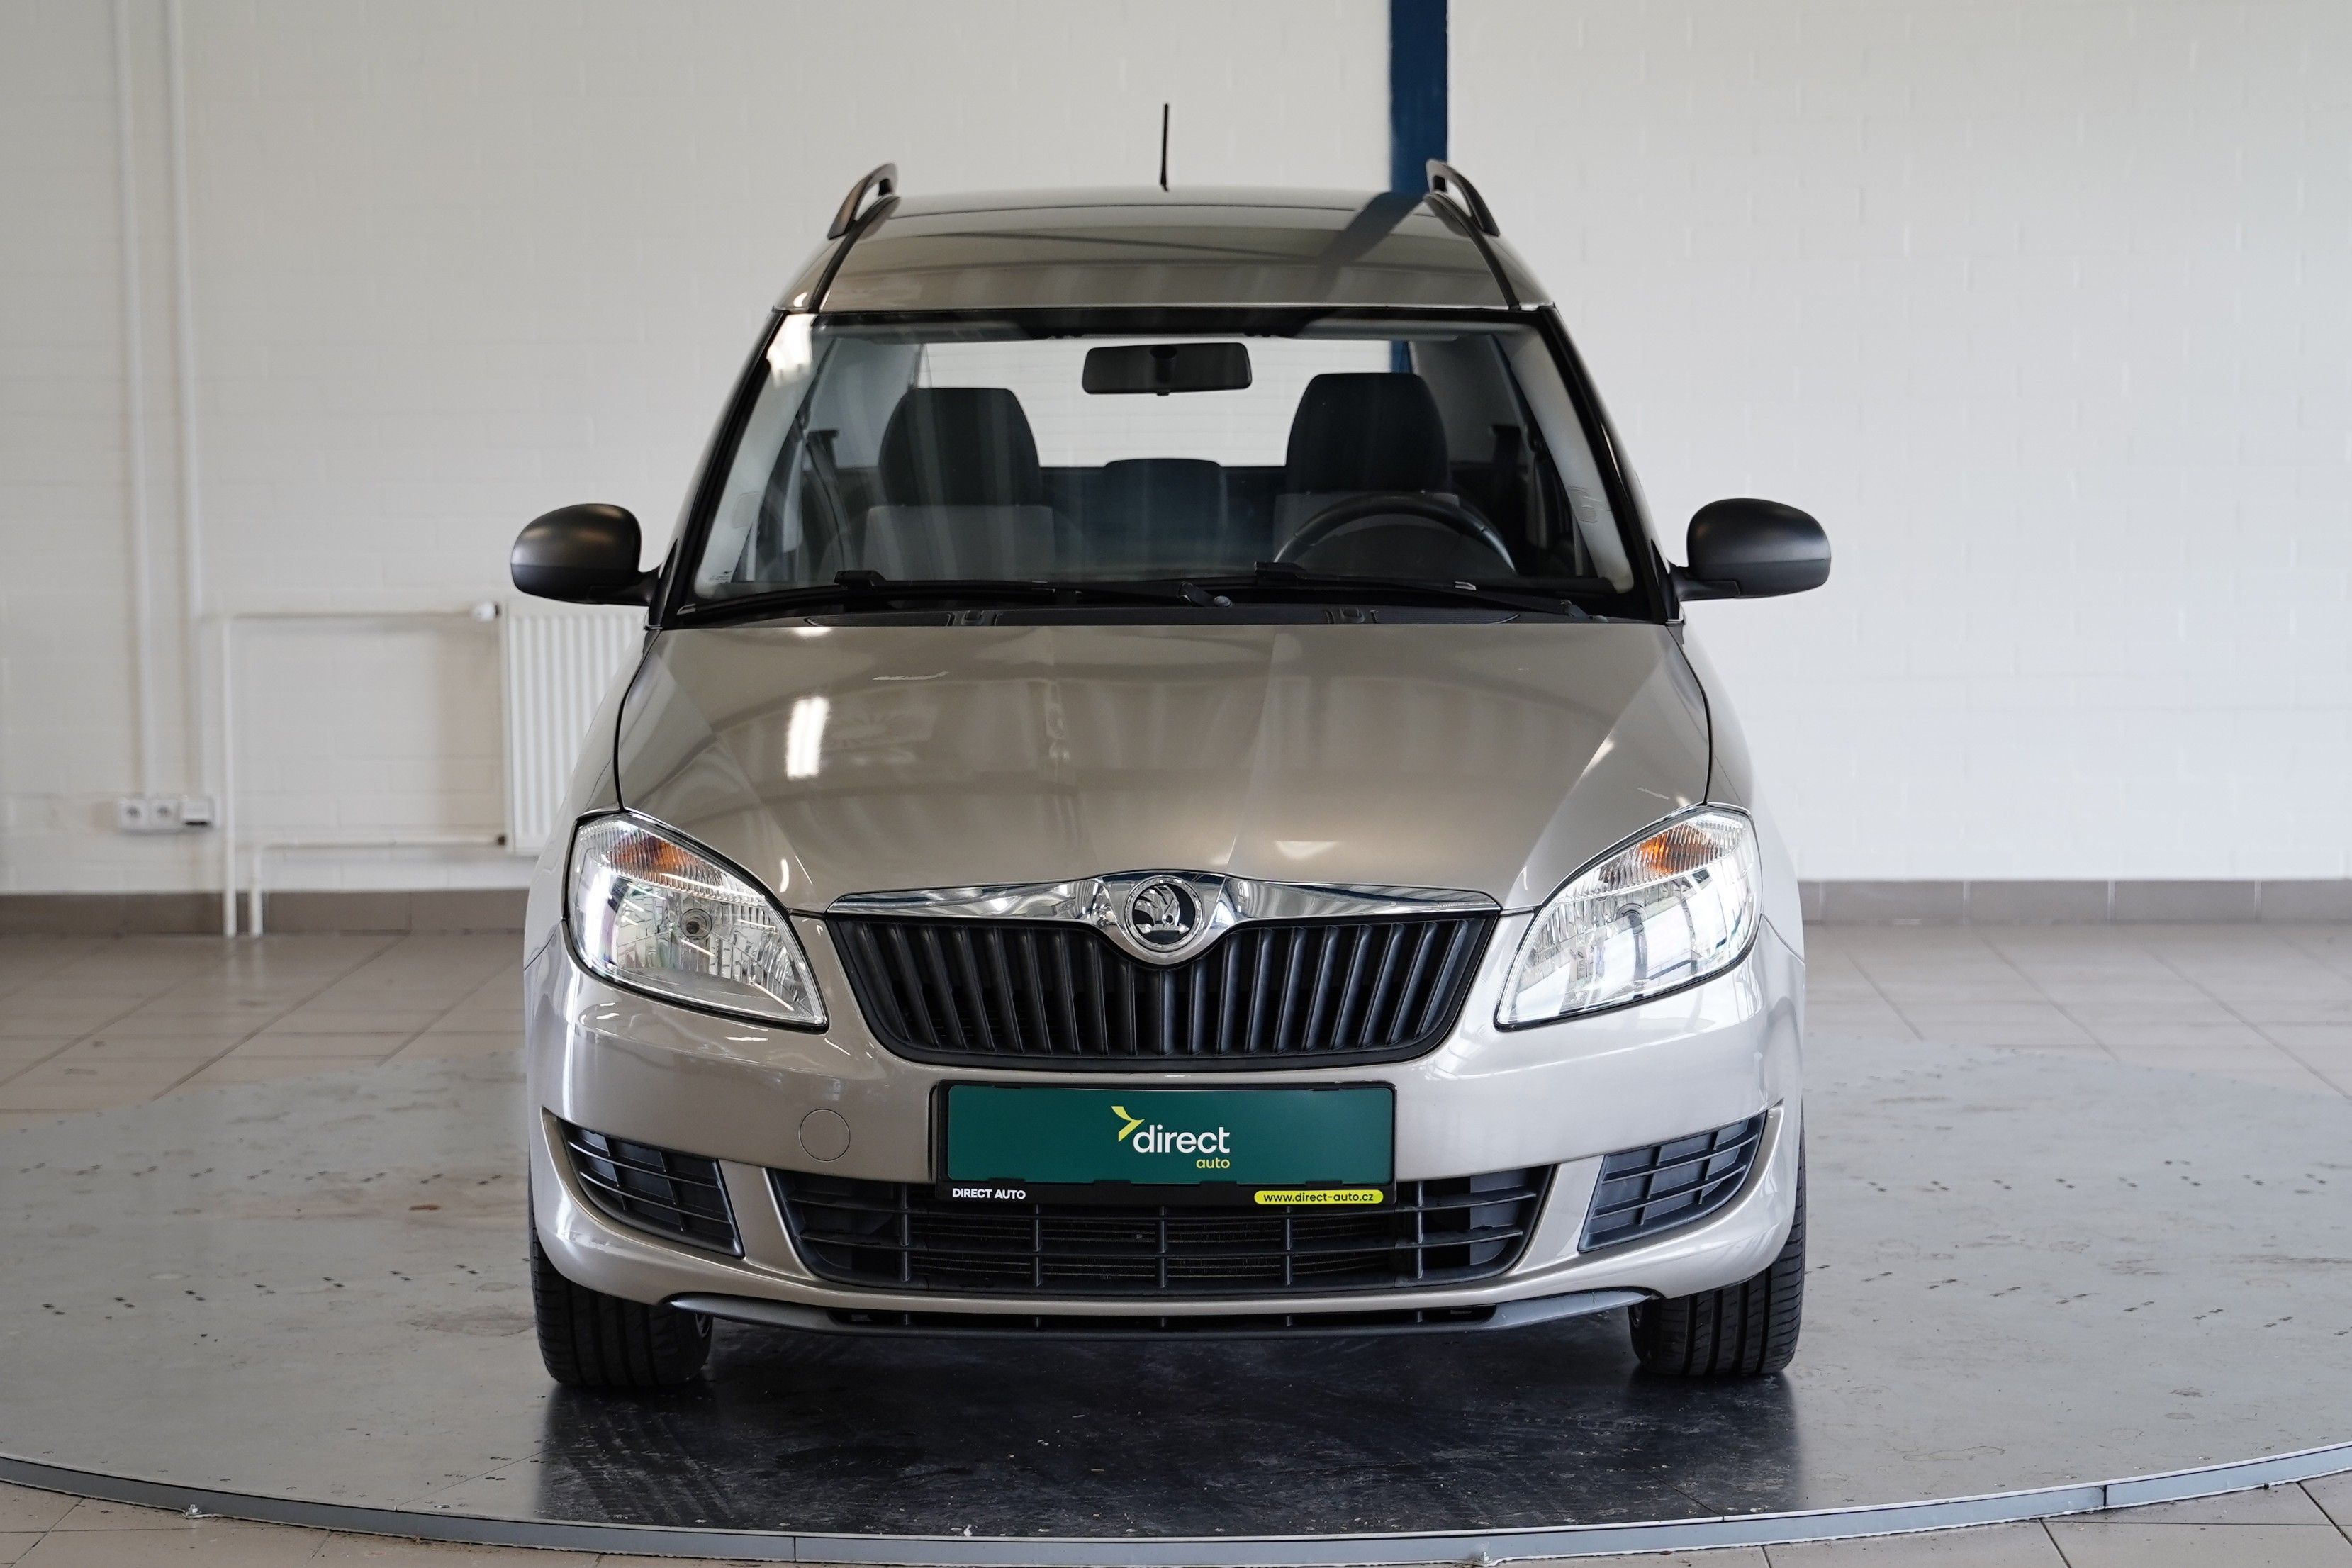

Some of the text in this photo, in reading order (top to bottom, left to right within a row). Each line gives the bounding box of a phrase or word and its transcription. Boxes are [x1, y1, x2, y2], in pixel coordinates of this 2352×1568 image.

[1133, 1124, 1231, 1153] direct
[1196, 1157, 1231, 1169] auto
[952, 1188, 1026, 1199] DIRECT AUTO
[1263, 1192, 1374, 1202] www.direct-auto.cz
